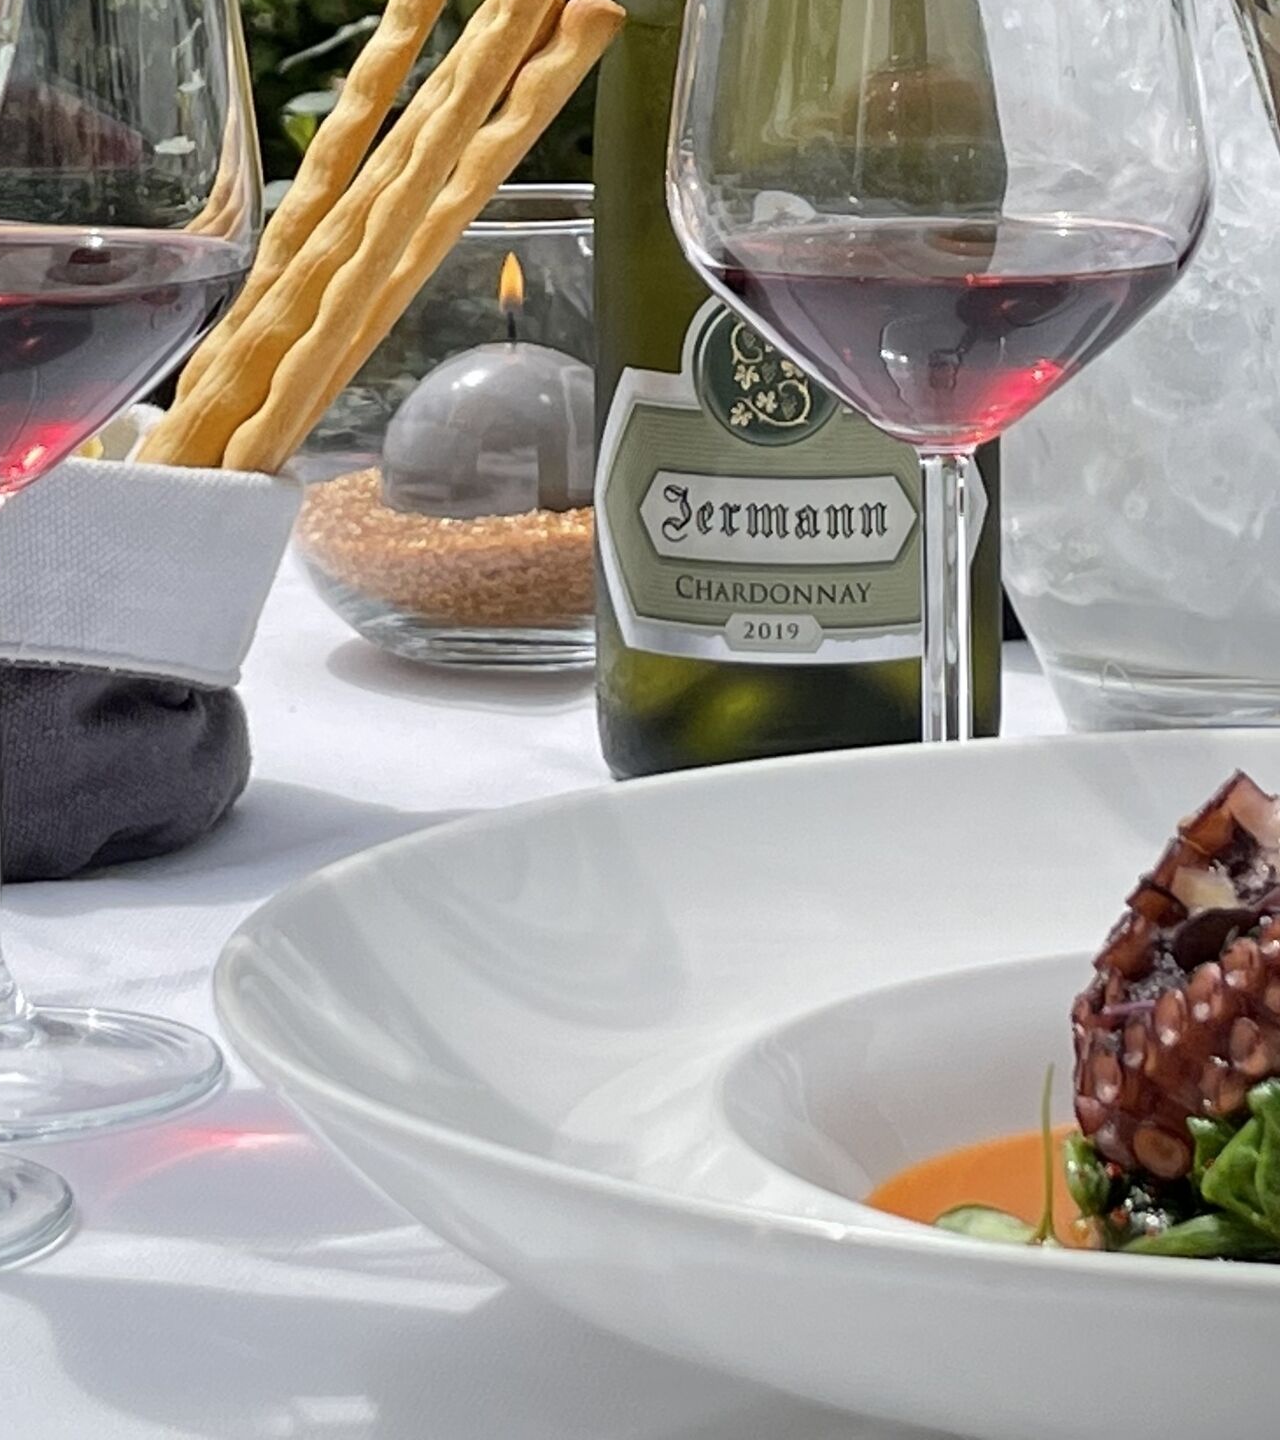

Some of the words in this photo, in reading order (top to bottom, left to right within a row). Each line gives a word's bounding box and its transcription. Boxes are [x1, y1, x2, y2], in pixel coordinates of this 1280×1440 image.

[662, 484, 889, 543] Jermann
[675, 574, 872, 605] CHARDONNAY
[743, 621, 800, 640] 2019
